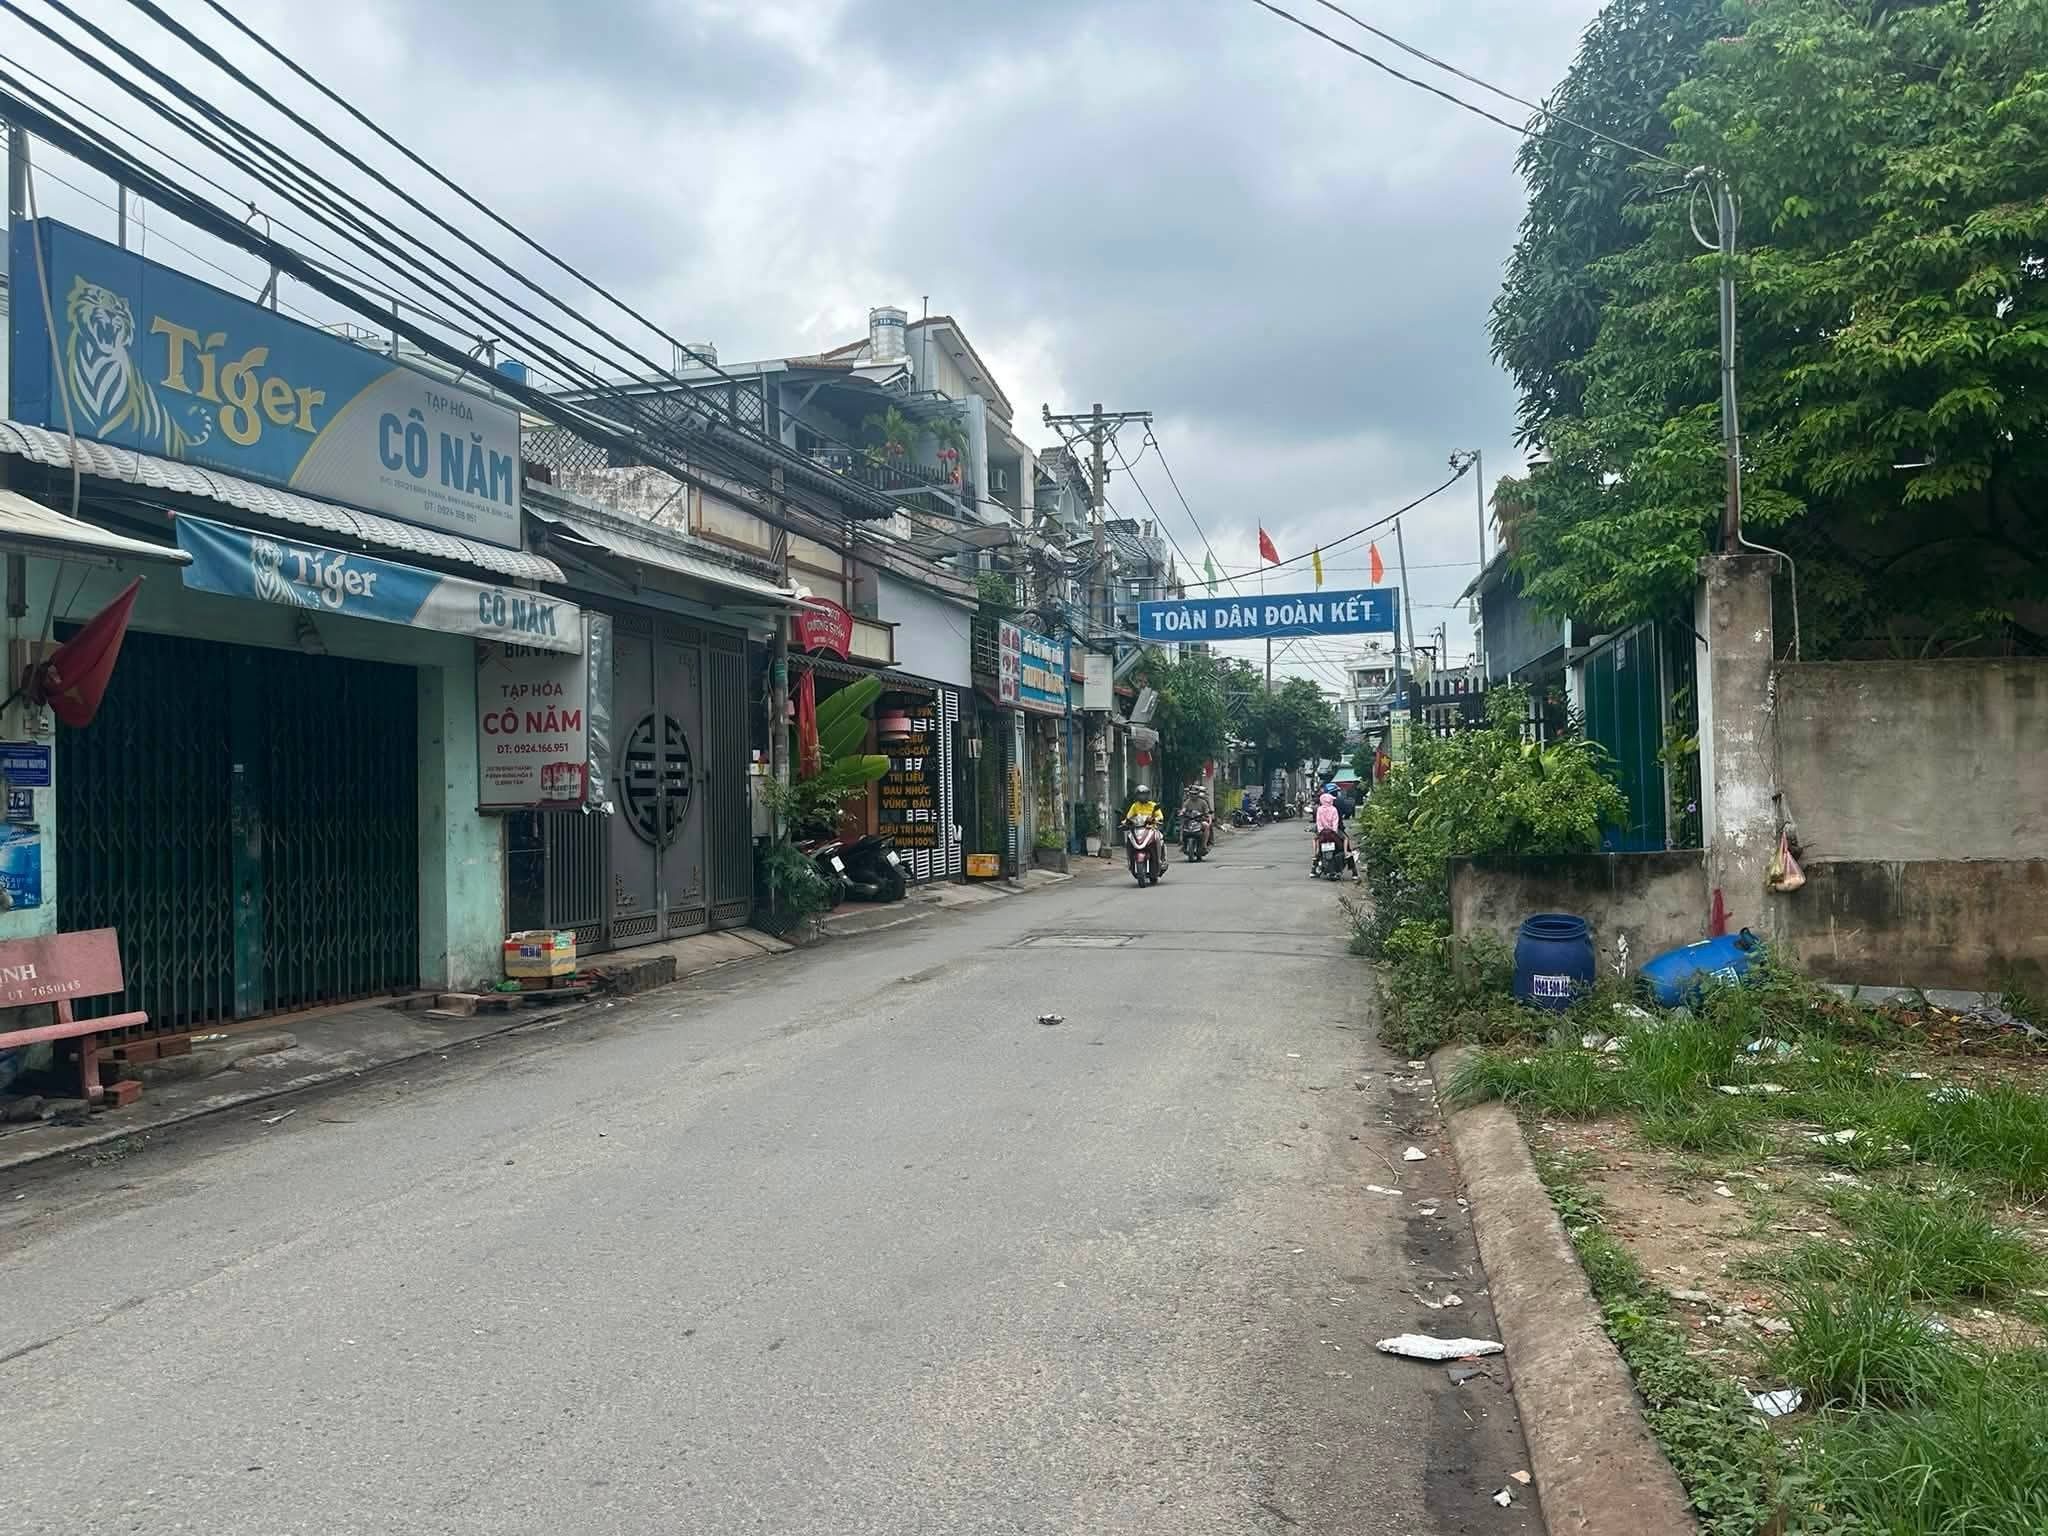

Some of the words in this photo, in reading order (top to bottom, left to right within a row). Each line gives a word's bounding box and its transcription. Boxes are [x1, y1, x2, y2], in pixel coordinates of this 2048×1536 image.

[151, 315, 326, 446] Tiger
[424, 391, 449, 414] TẠP
[450, 400, 474, 422] HÓA
[379, 407, 429, 479] CÔ
[440, 431, 513, 507] NĂM
[289, 548, 377, 608] Tiger
[479, 588, 506, 627] CÔ
[512, 594, 557, 637] NĂM
[1152, 606, 1207, 632] TOÀN
[1215, 604, 1258, 629] DÂN
[1264, 599, 1324, 626] ĐOÀN
[1331, 593, 1375, 623] KẾT
[501, 683, 529, 701] TẠP
[531, 680, 563, 697] HÓA
[483, 706, 519, 735] CÔ
[526, 704, 582, 734] NĂM
